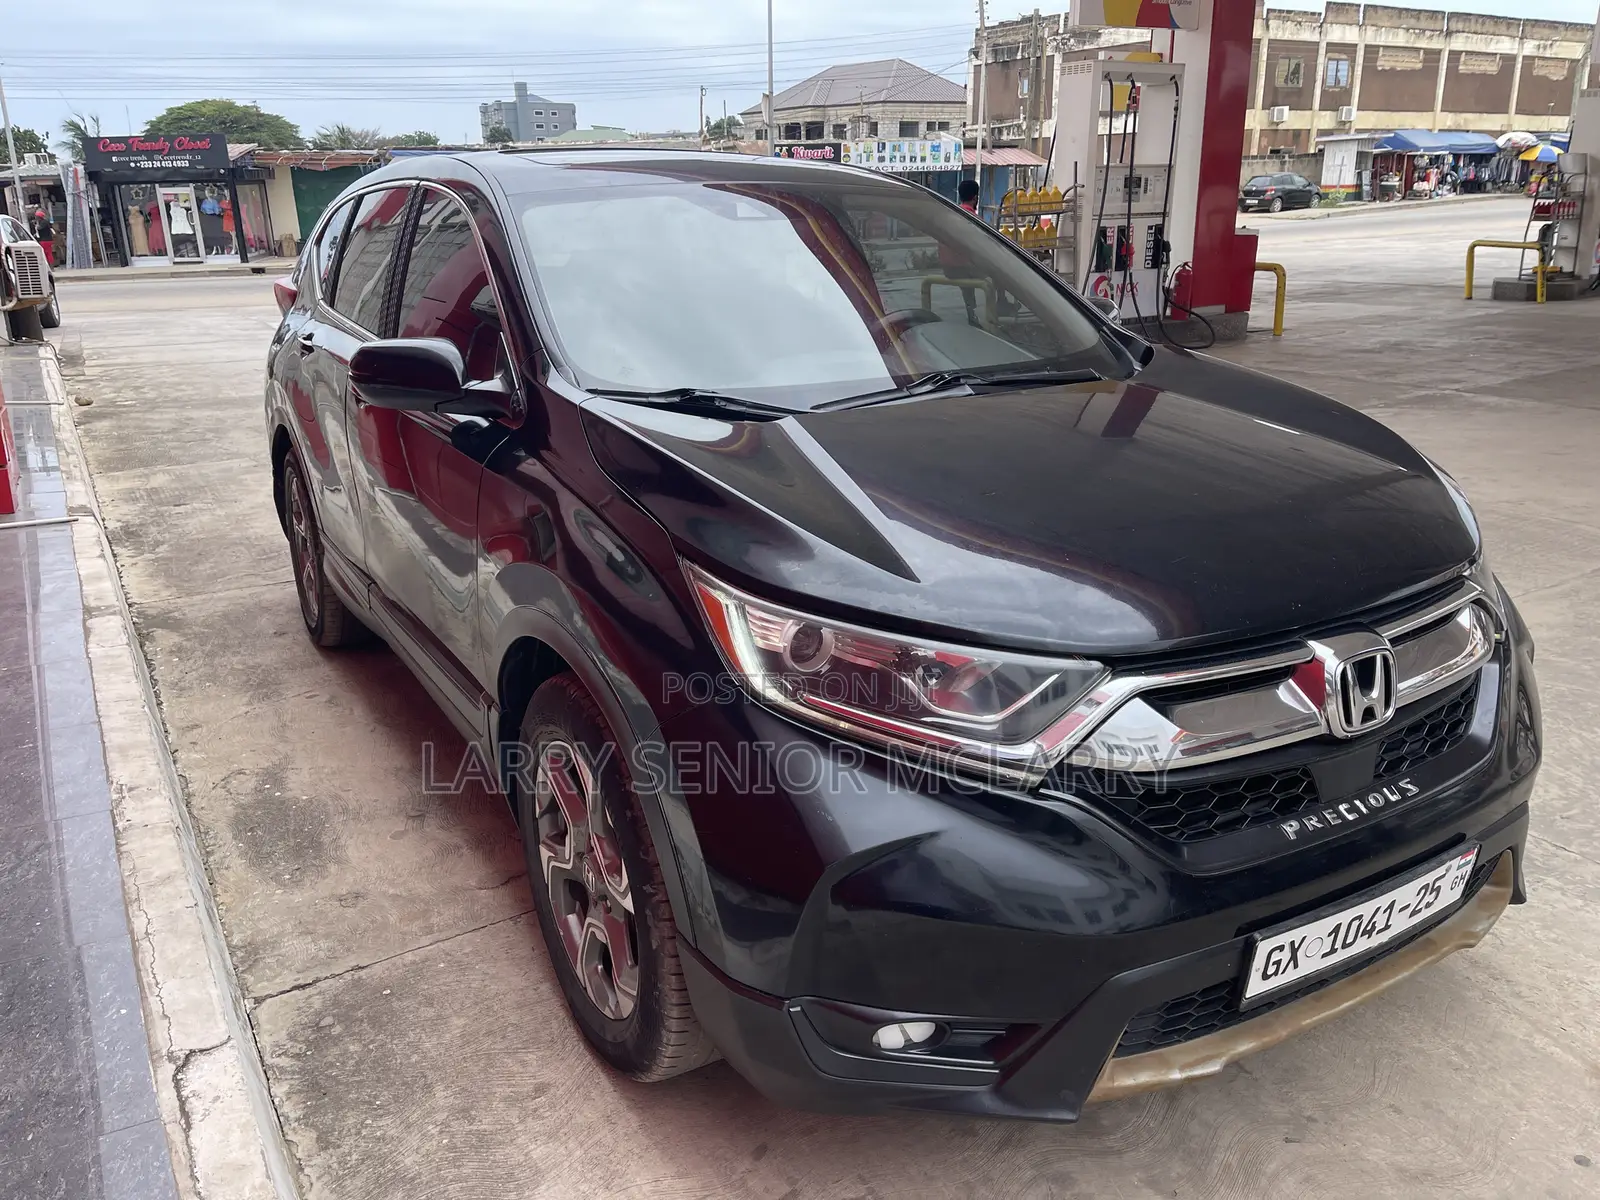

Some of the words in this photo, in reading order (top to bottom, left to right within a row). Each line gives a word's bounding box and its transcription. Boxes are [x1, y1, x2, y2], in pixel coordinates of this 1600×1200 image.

[128, 136, 171, 155] Trendy
[173, 136, 212, 151] Closet
[1144, 225, 1156, 268] DIESEL
[1279, 777, 1421, 841] PRECIOUS
[1261, 935, 1308, 982] GX
[1320, 872, 1448, 959] 1041-25
[1450, 870, 1468, 891] GH
